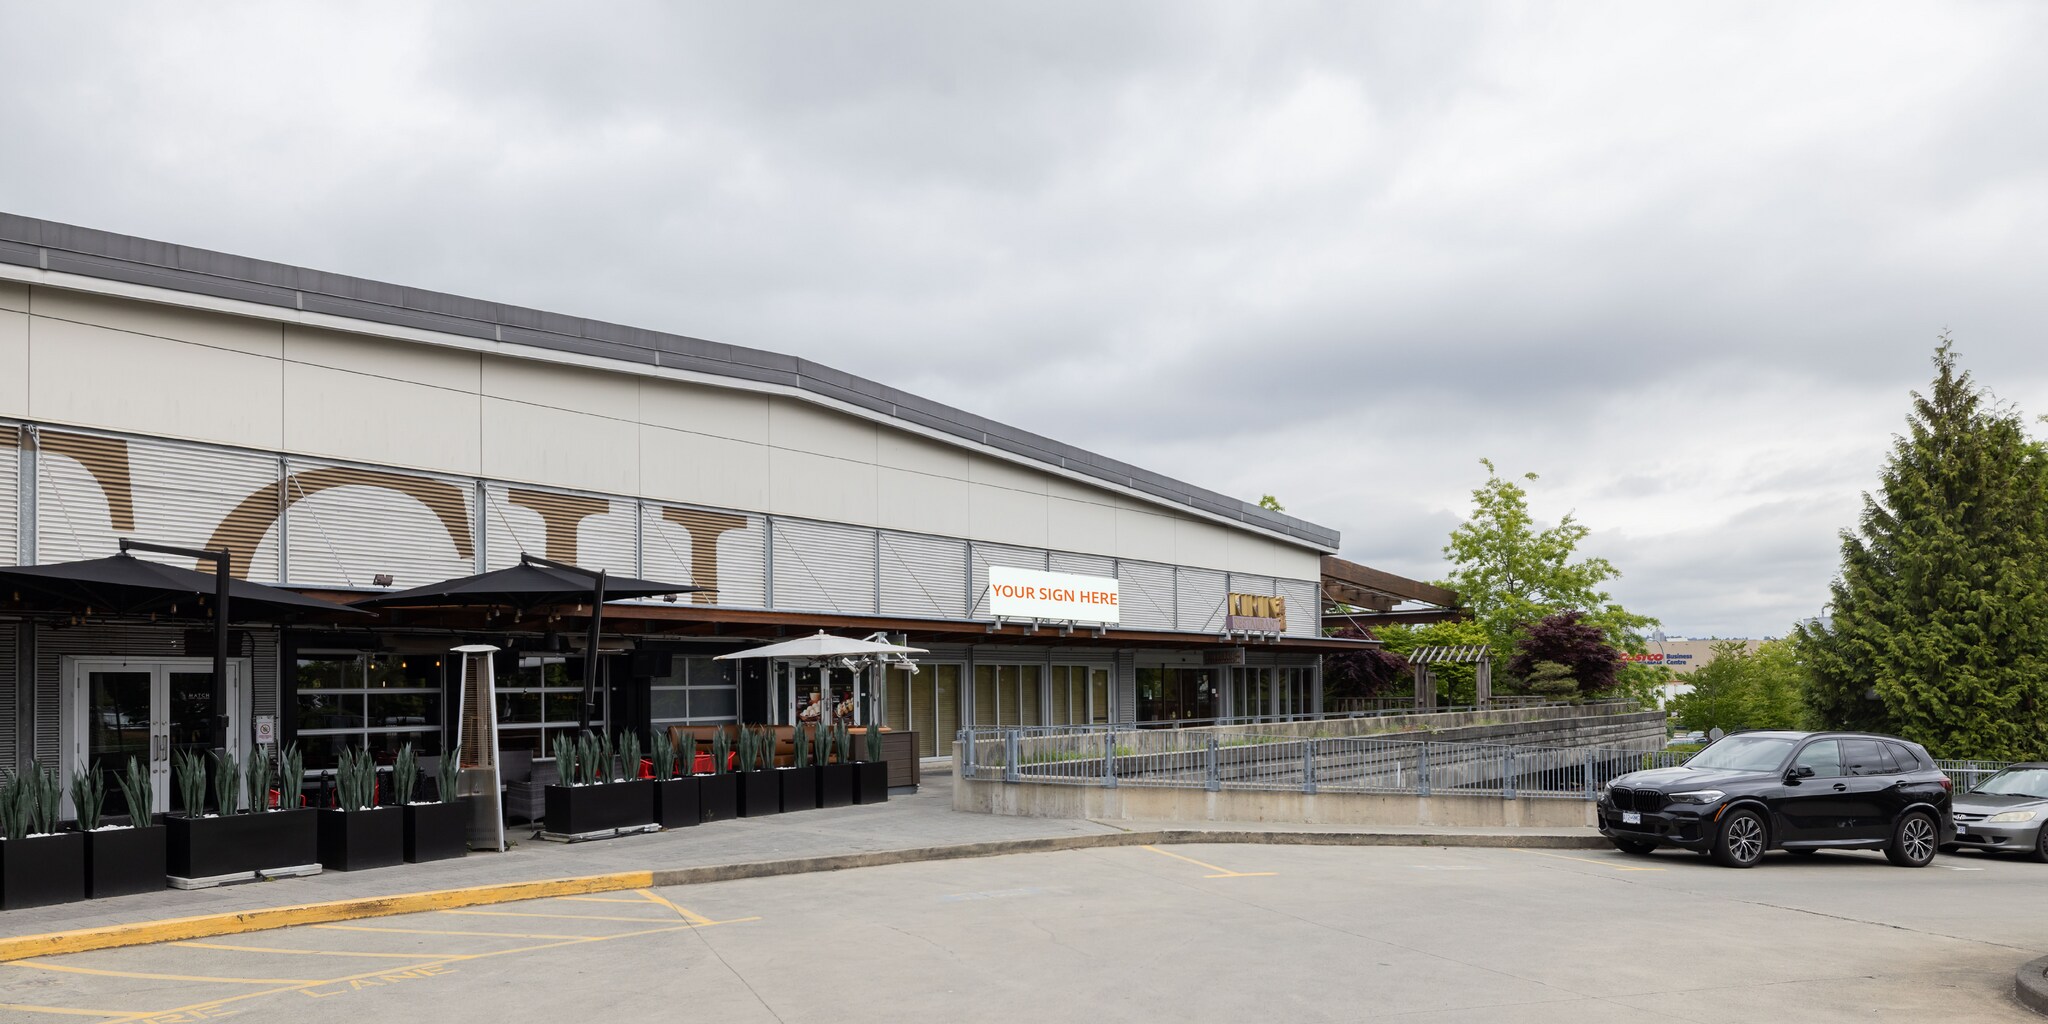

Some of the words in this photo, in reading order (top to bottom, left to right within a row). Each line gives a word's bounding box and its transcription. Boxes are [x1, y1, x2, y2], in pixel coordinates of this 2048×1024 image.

[993, 584, 1035, 599] YOUR
[1040, 588, 1074, 602] SIGN
[1081, 591, 1117, 605] HERE
